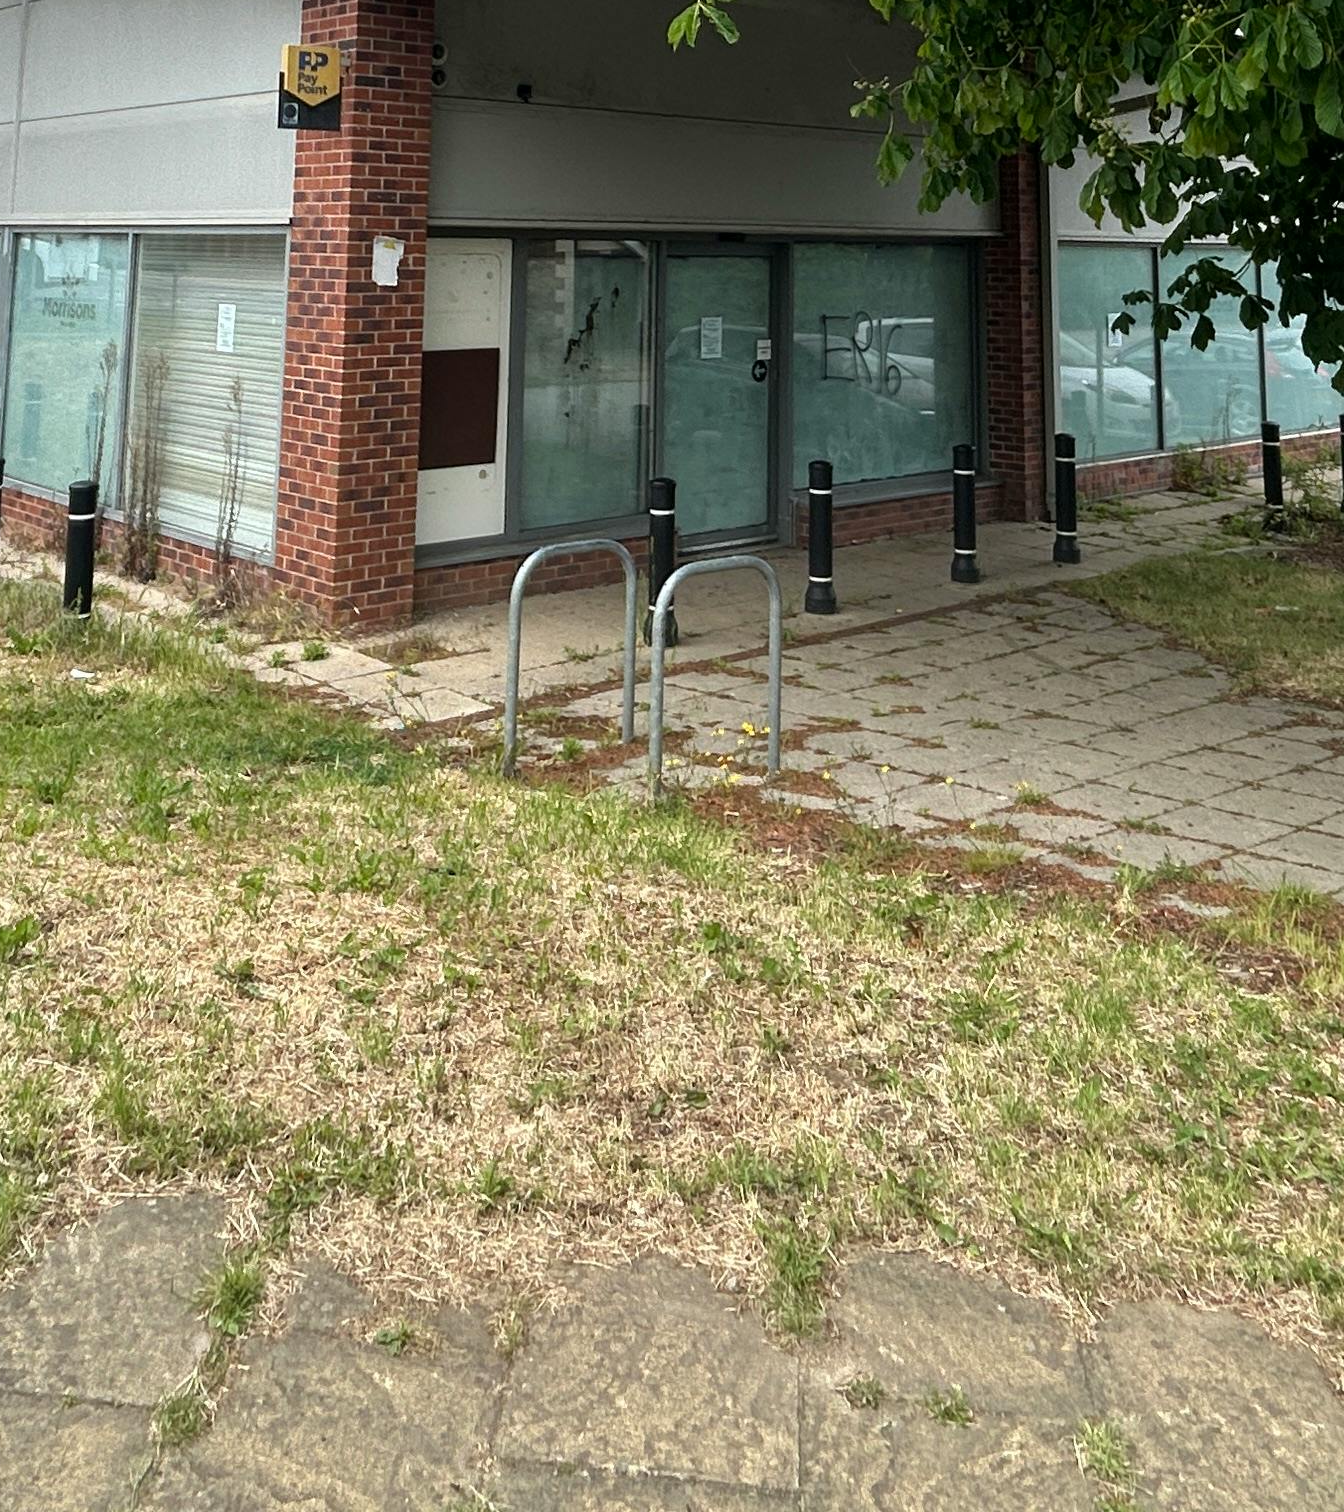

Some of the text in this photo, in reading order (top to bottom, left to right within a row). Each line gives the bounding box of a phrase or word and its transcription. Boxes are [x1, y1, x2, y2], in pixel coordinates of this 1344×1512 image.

[298, 72, 318, 85] Pay
[298, 83, 328, 95] Point
[41, 296, 96, 320] Morrisons
